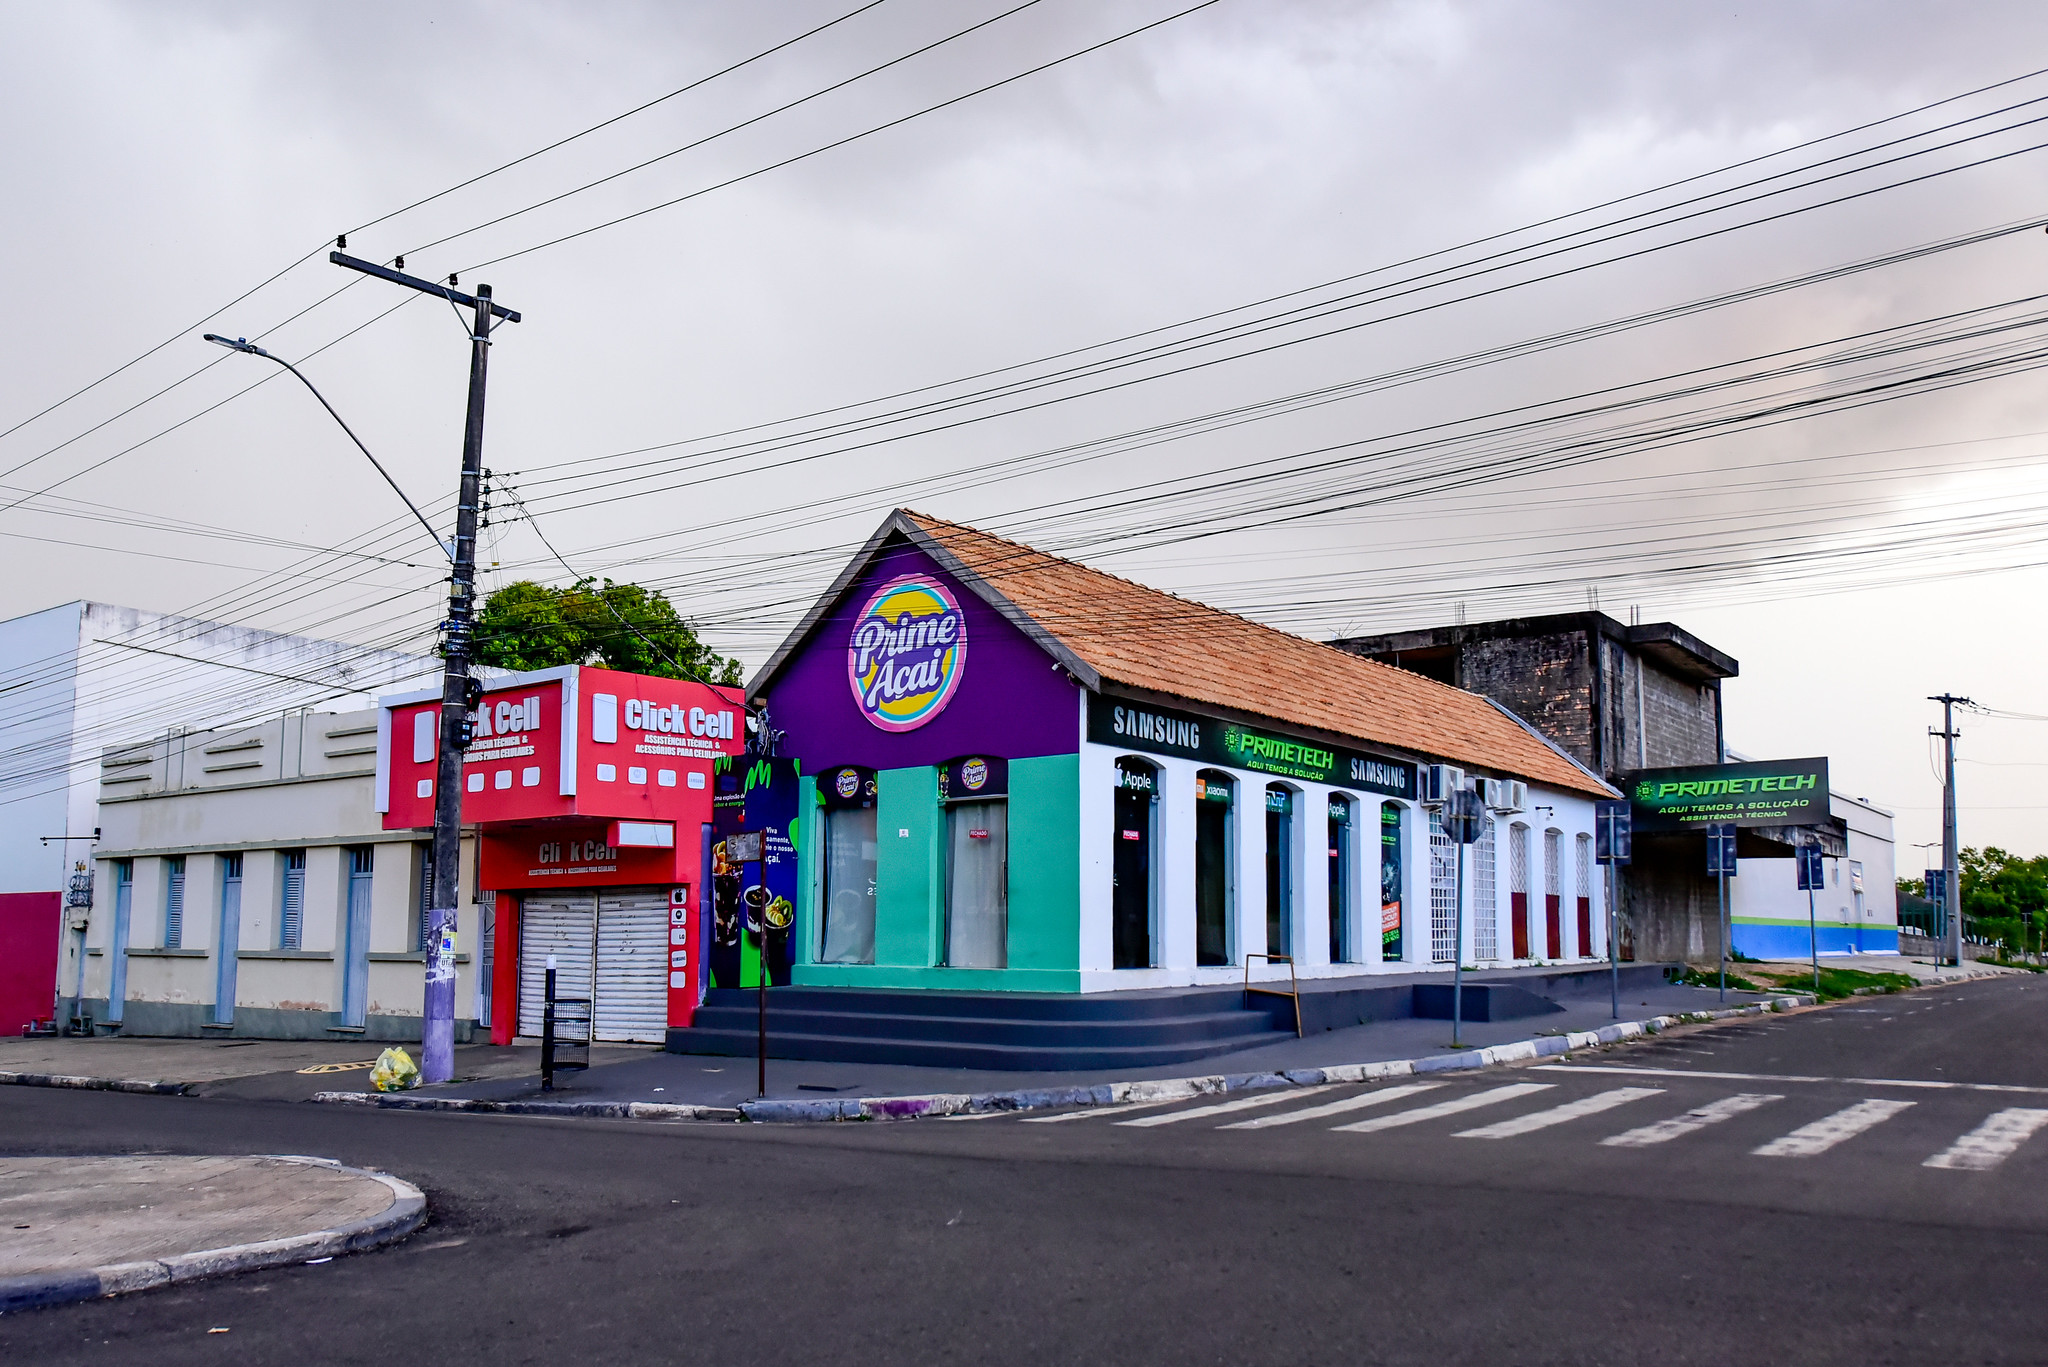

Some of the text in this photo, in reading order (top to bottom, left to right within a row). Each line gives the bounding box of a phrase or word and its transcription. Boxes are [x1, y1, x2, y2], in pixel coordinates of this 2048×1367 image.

[855, 615, 956, 673] Prime
[495, 696, 540, 735] Cell
[624, 698, 734, 739] Click Cell
[1113, 705, 1200, 749] SAMSUNG
[522, 735, 528, 744] &
[644, 734, 720, 749] ASSISTÊNCIA TÉCNICA &
[500, 745, 535, 758] CELULARES
[635, 744, 676, 756] ACESSÓRIOS
[677, 747, 693, 757] PARA
[1240, 733, 1334, 770] PRIMETECH
[1247, 760, 1324, 781] AQUI TEMOS A SOLUÇÃO
[1350, 757, 1406, 789] SAMSUNG
[1124, 770, 1151, 790] Apple
[1658, 774, 1817, 798] PRIMETECH
[1206, 784, 1229, 797] xiaomi
[1328, 802, 1346, 817] Apple
[1658, 799, 1809, 814] AQUI TEMOS A SOLUÇÃO
[1679, 810, 1788, 821] ASSISTÊNCIA TÉCNICA
[765, 826, 778, 834] Viva
